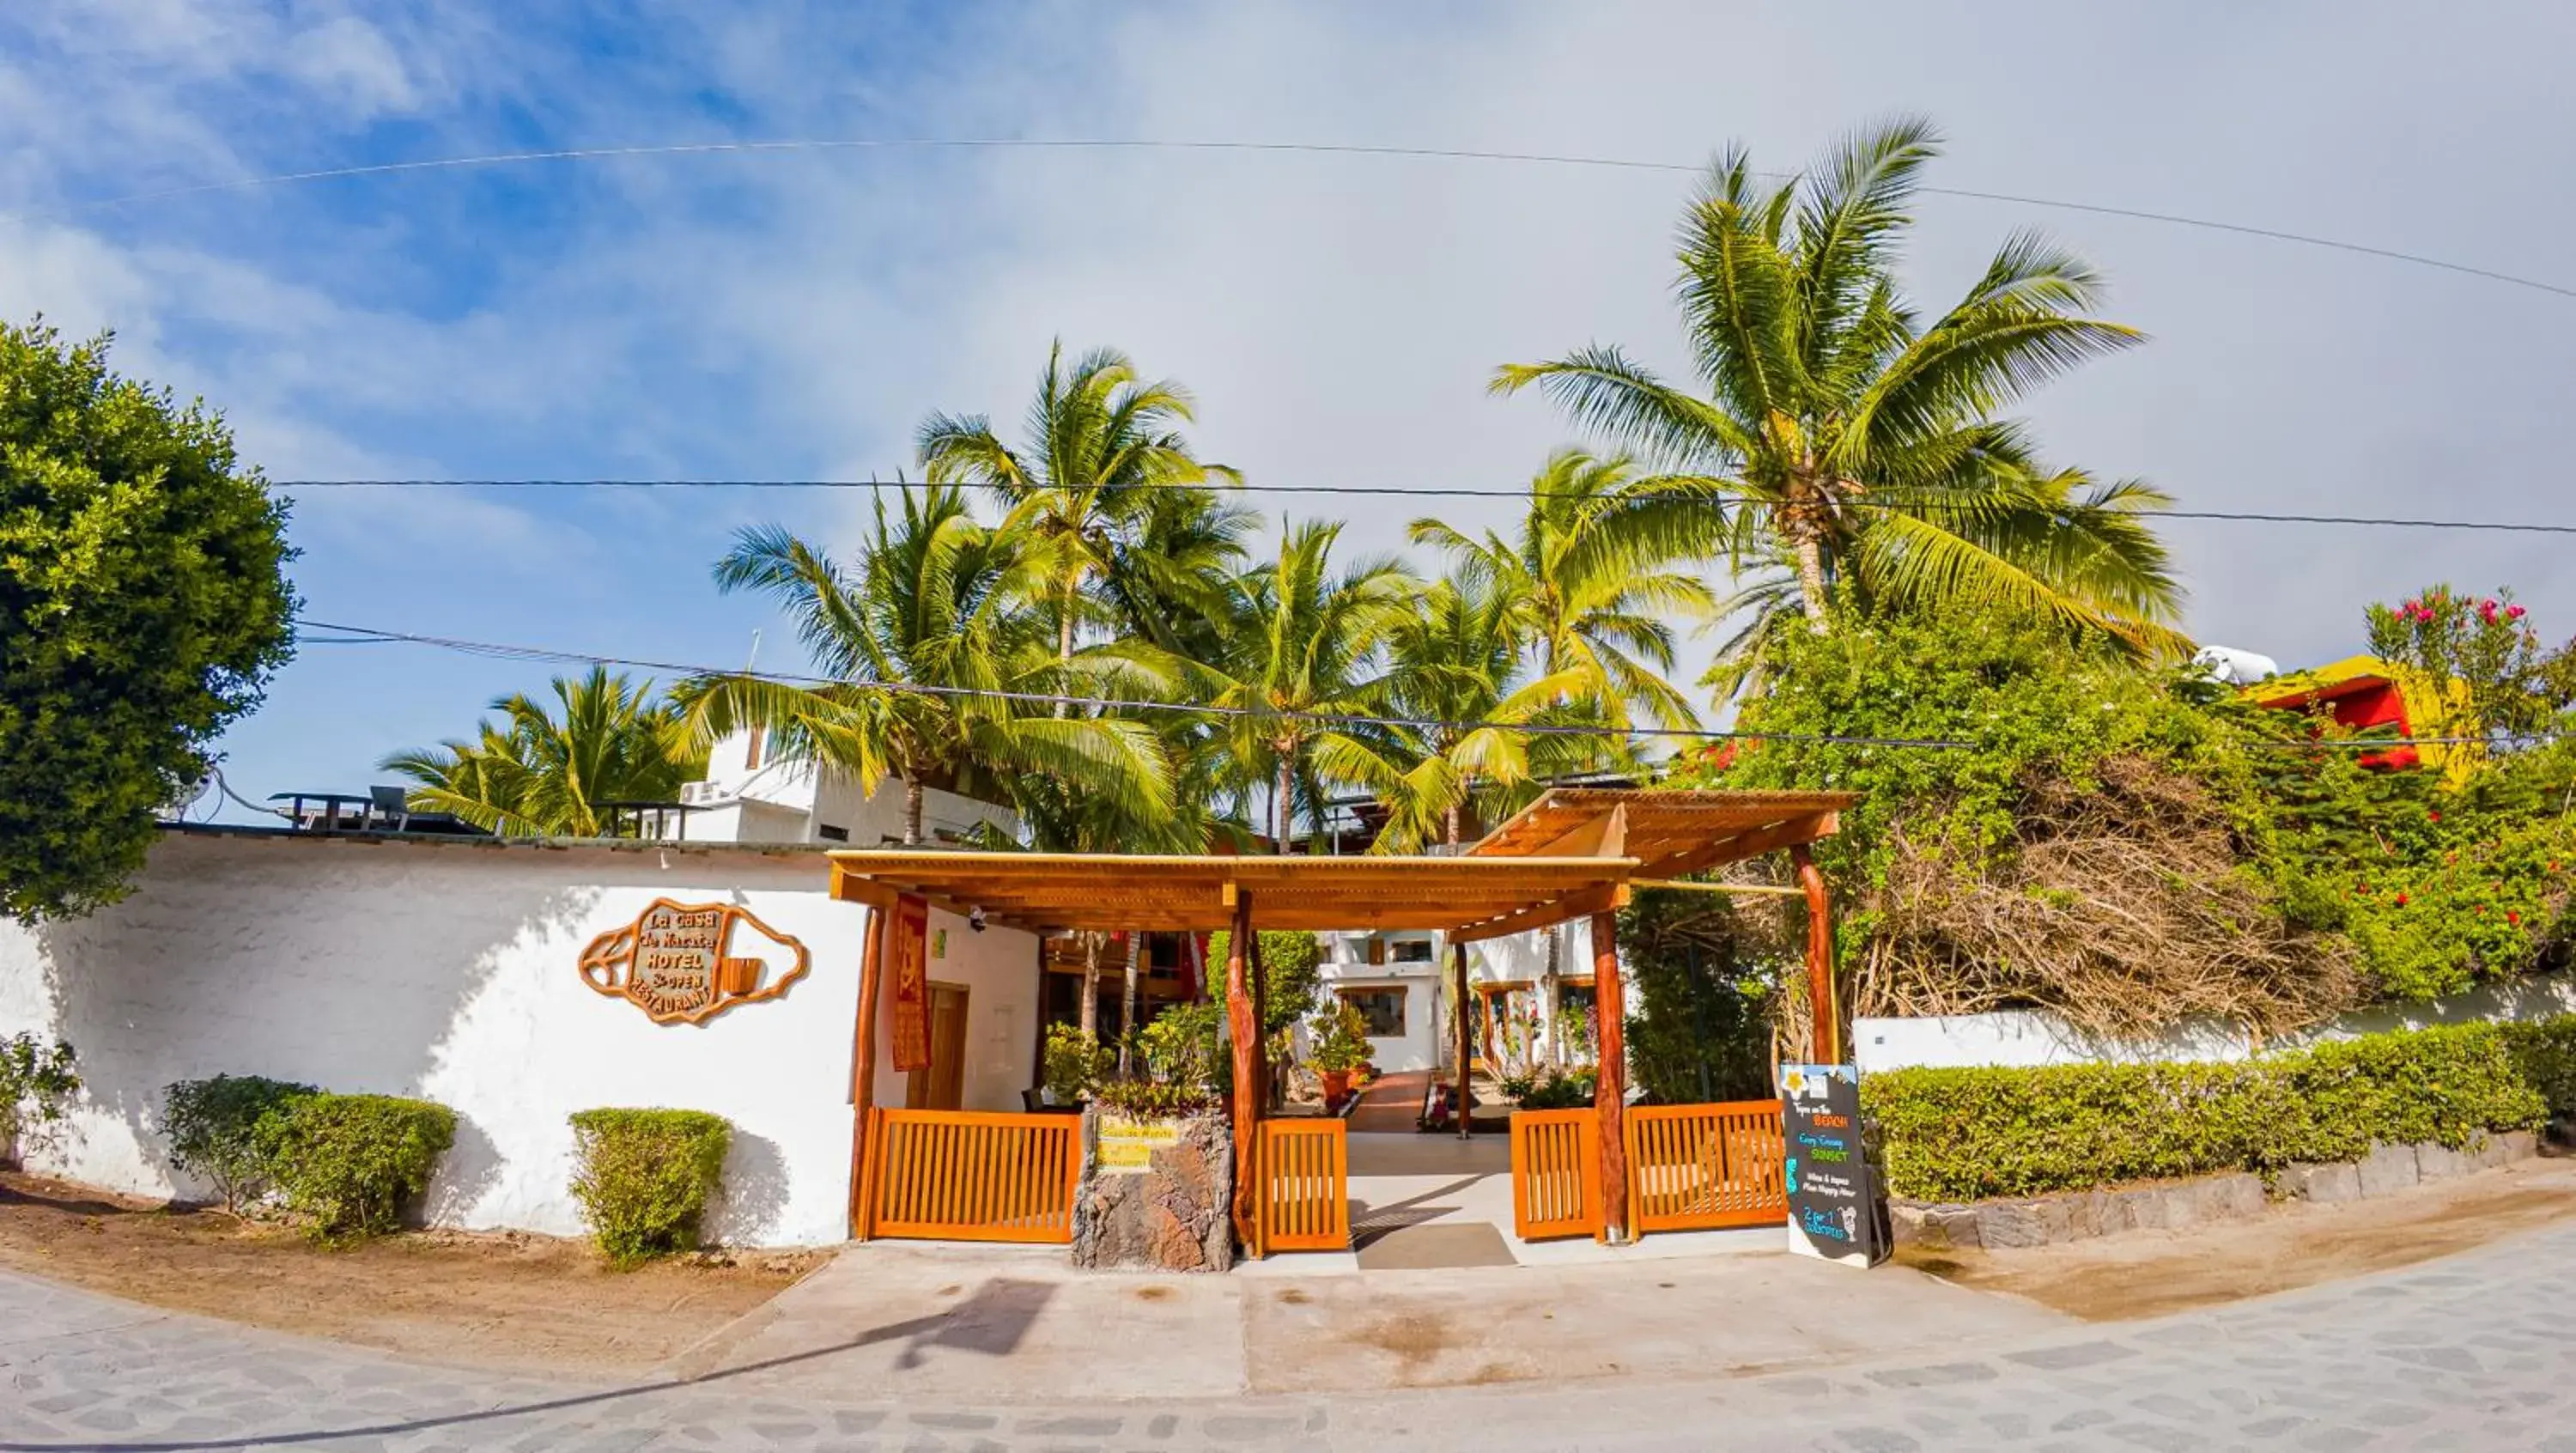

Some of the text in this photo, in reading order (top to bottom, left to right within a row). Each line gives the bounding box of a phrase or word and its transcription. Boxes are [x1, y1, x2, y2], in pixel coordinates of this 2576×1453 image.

[649, 911, 716, 929] La Casa
[640, 932, 659, 947] de
[647, 954, 704, 970] HOTEL
[669, 976, 703, 989] OPEN
[630, 977, 710, 1013] RESTAURANT
[1813, 1114, 1848, 1128] BEACH
[1812, 1148, 1850, 1162] SUNSET
[1804, 1207, 1812, 1220] 2
[1827, 1212, 1833, 1224] 1
